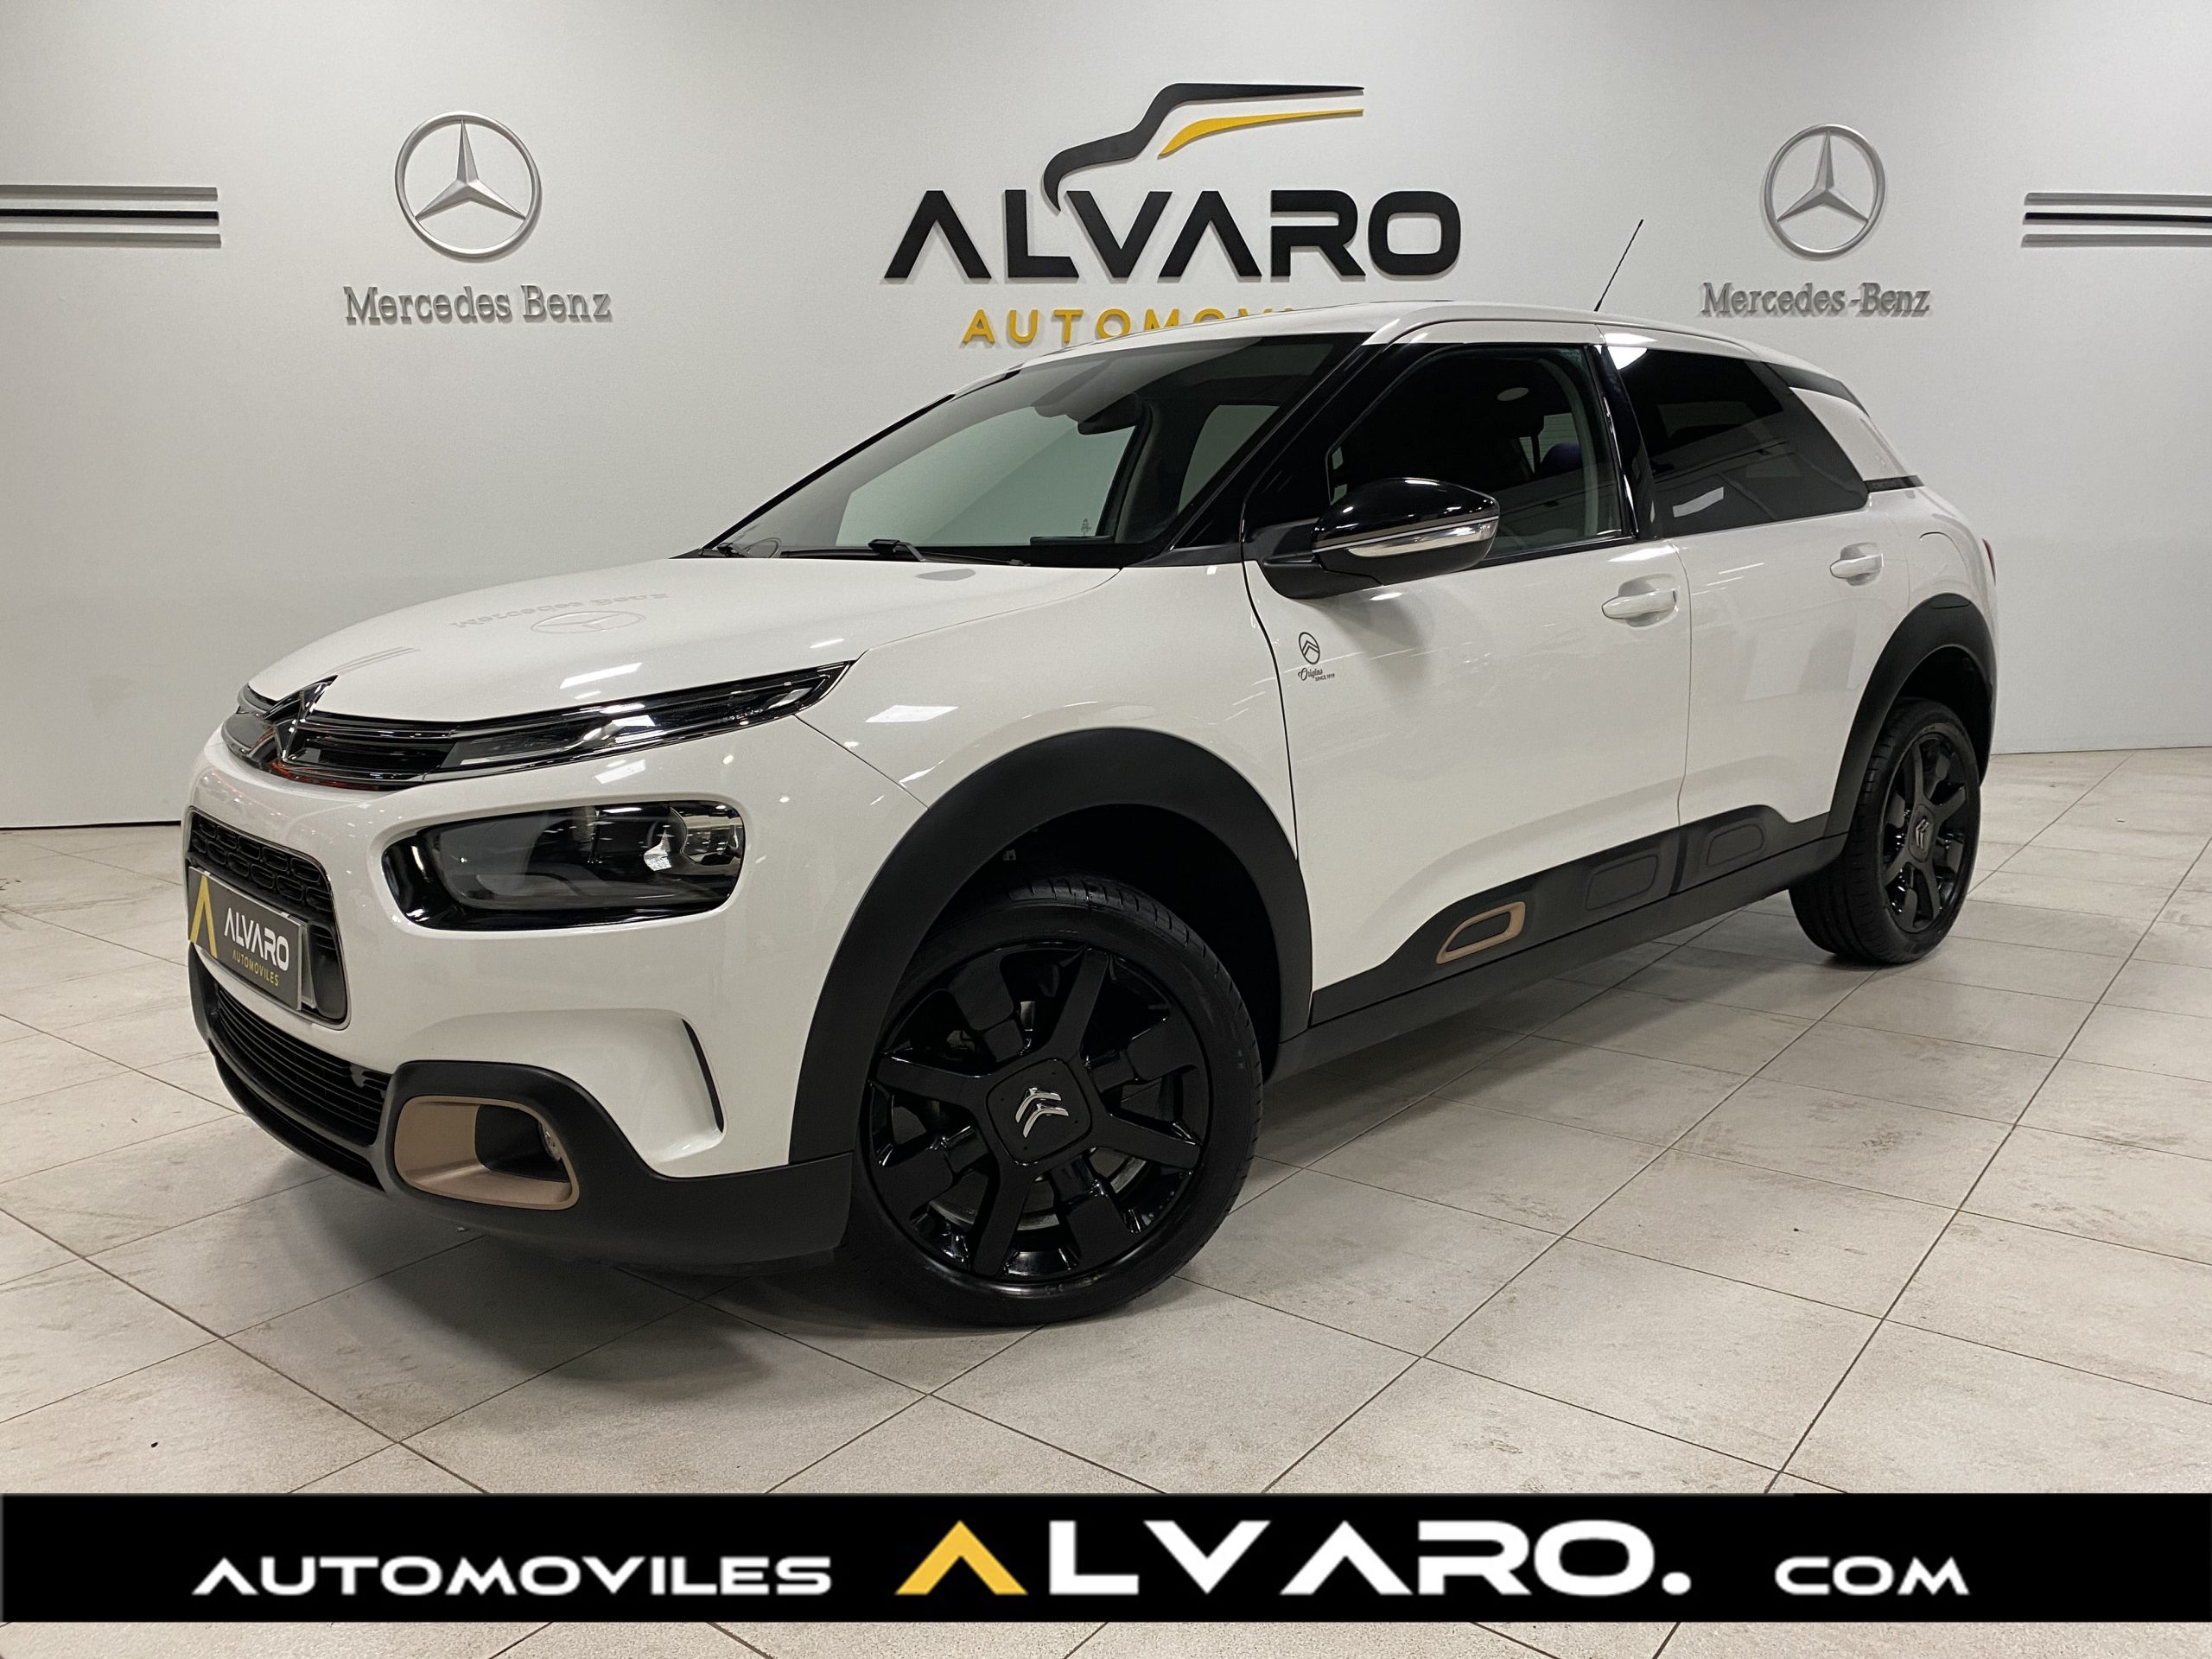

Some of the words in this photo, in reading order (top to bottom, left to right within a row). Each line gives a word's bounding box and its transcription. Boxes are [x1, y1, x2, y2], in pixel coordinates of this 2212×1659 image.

[881, 189, 1462, 279] ALVARO
[343, 286, 512, 325] Mercedes
[520, 284, 613, 323] Benz
[1700, 282, 1932, 318] Mercedes-Benz
[224, 907, 289, 971] ALVARO
[232, 949, 279, 987] AUTOMOVILES
